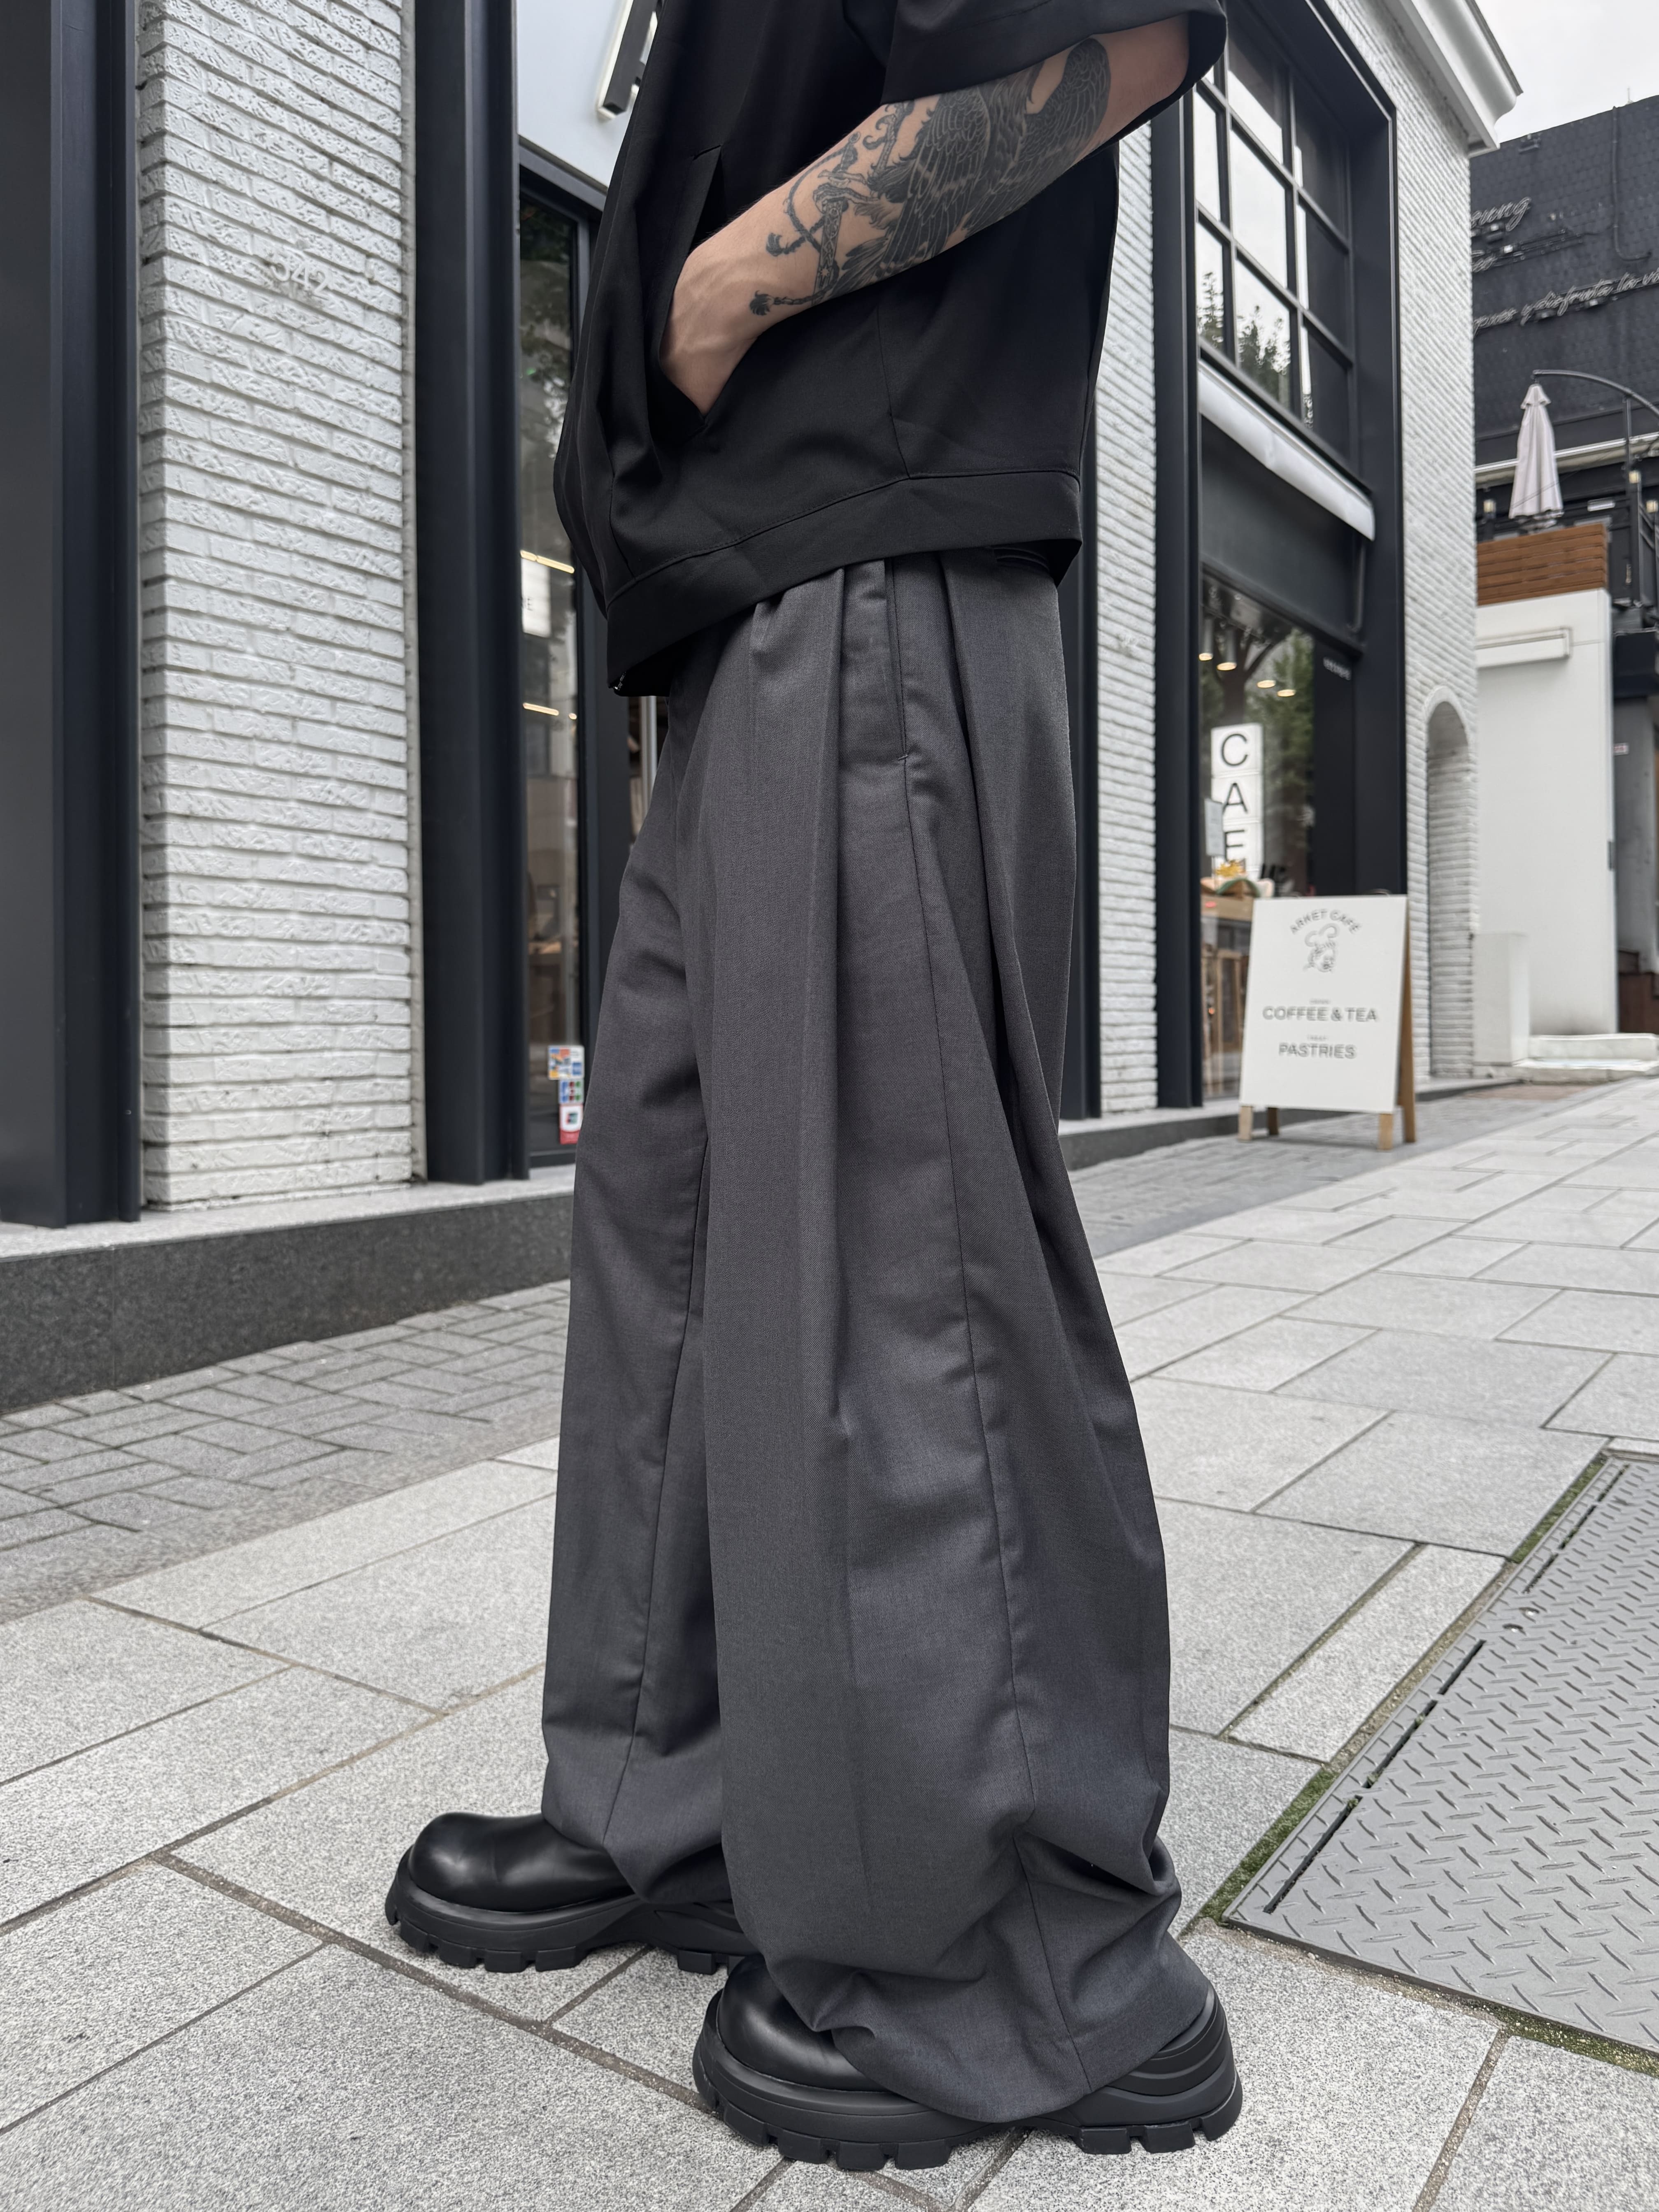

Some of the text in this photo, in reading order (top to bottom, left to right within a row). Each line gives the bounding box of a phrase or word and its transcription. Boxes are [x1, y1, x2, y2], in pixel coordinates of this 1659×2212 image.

[1262, 1006, 1378, 1022] COFFEE & TEA
[1278, 1042, 1357, 1059] PASTRIES
